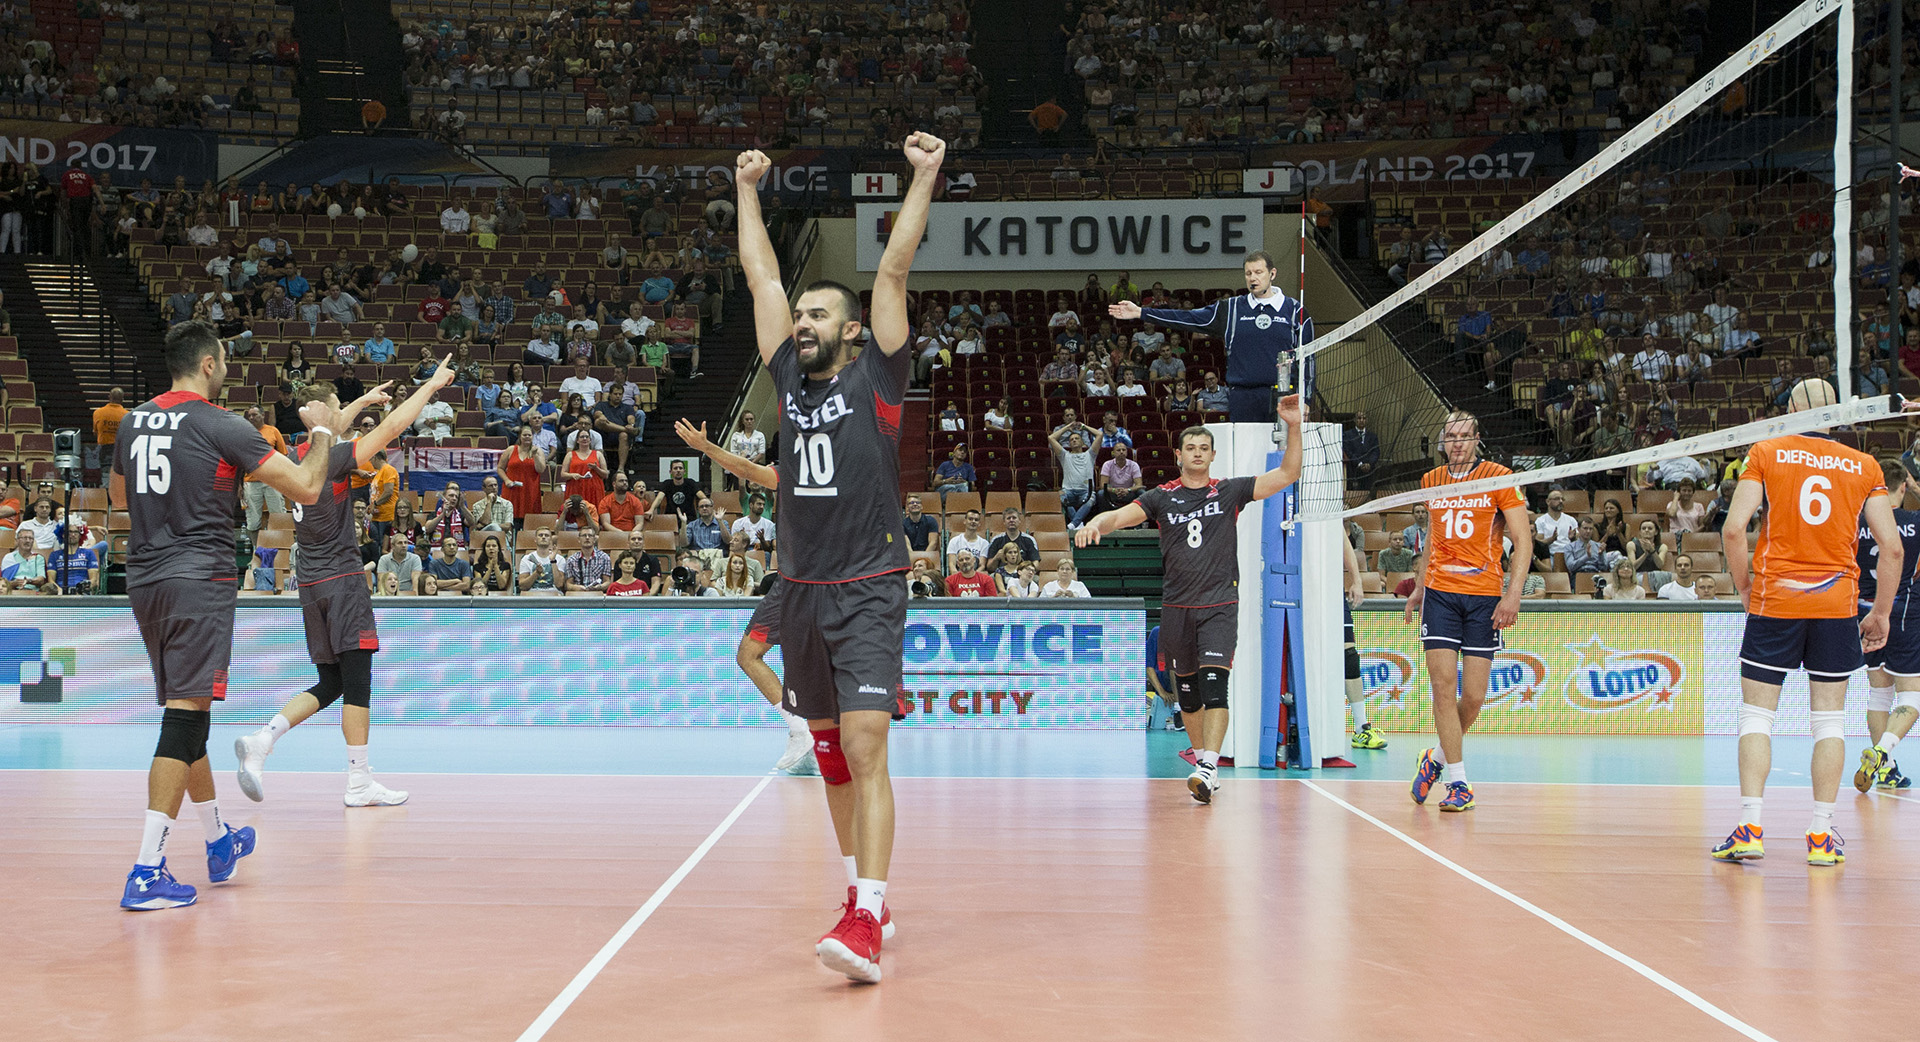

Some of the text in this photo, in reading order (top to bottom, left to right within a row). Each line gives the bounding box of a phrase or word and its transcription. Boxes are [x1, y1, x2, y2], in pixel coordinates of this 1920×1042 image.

[66, 140, 157, 171] 2017
[1444, 151, 1535, 180] 2017
[635, 164, 828, 192] KTOICE
[865, 175, 883, 194] H
[1260, 171, 1275, 190] J
[964, 214, 1247, 256] KATOWICE
[131, 411, 188, 430] TOY
[130, 434, 172, 495] 15
[794, 432, 835, 486] 10
[1776, 449, 1862, 475] DIEFENBACH
[1167, 501, 1224, 525] VESTEL
[1429, 494, 1491, 509] Rabobank
[1799, 475, 1832, 525] 6
[1187, 518, 1203, 549] 8
[1441, 508, 1474, 539] 16
[1588, 663, 1660, 698] LOTTO
[949, 690, 1035, 714] CITY
